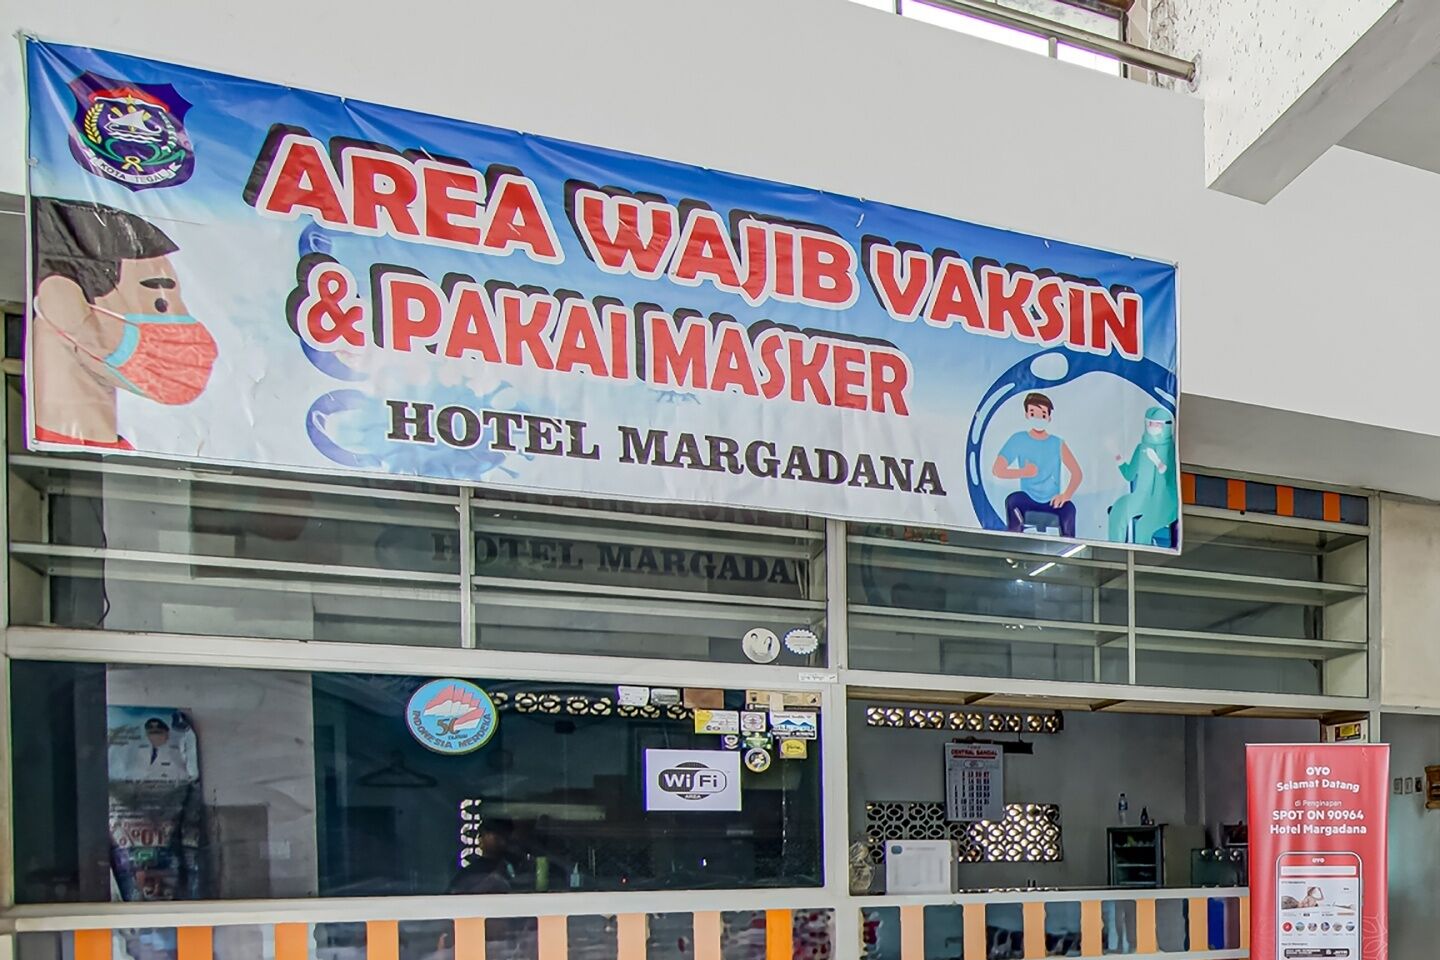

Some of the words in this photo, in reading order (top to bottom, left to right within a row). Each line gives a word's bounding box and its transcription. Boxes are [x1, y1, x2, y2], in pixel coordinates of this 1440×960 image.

[100, 163, 126, 180] KOTA
[258, 132, 564, 263] AREA
[574, 187, 858, 309] WAJIB
[868, 243, 1143, 360] VAKSIN
[299, 262, 365, 352] &
[383, 272, 634, 381] PAKAI
[644, 309, 912, 418] MASKER
[386, 399, 600, 461] HOTEL
[618, 425, 947, 497] MARGADANA
[1306, 767, 1330, 776] OYO
[1276, 780, 1319, 792] Selamat
[1321, 779, 1360, 793] Datang
[1272, 810, 1305, 820] SPOT
[1307, 810, 1325, 820] ON
[1327, 810, 1365, 820] 90964
[1270, 824, 1301, 834] Hotel
[1303, 824, 1367, 836] Margadana
